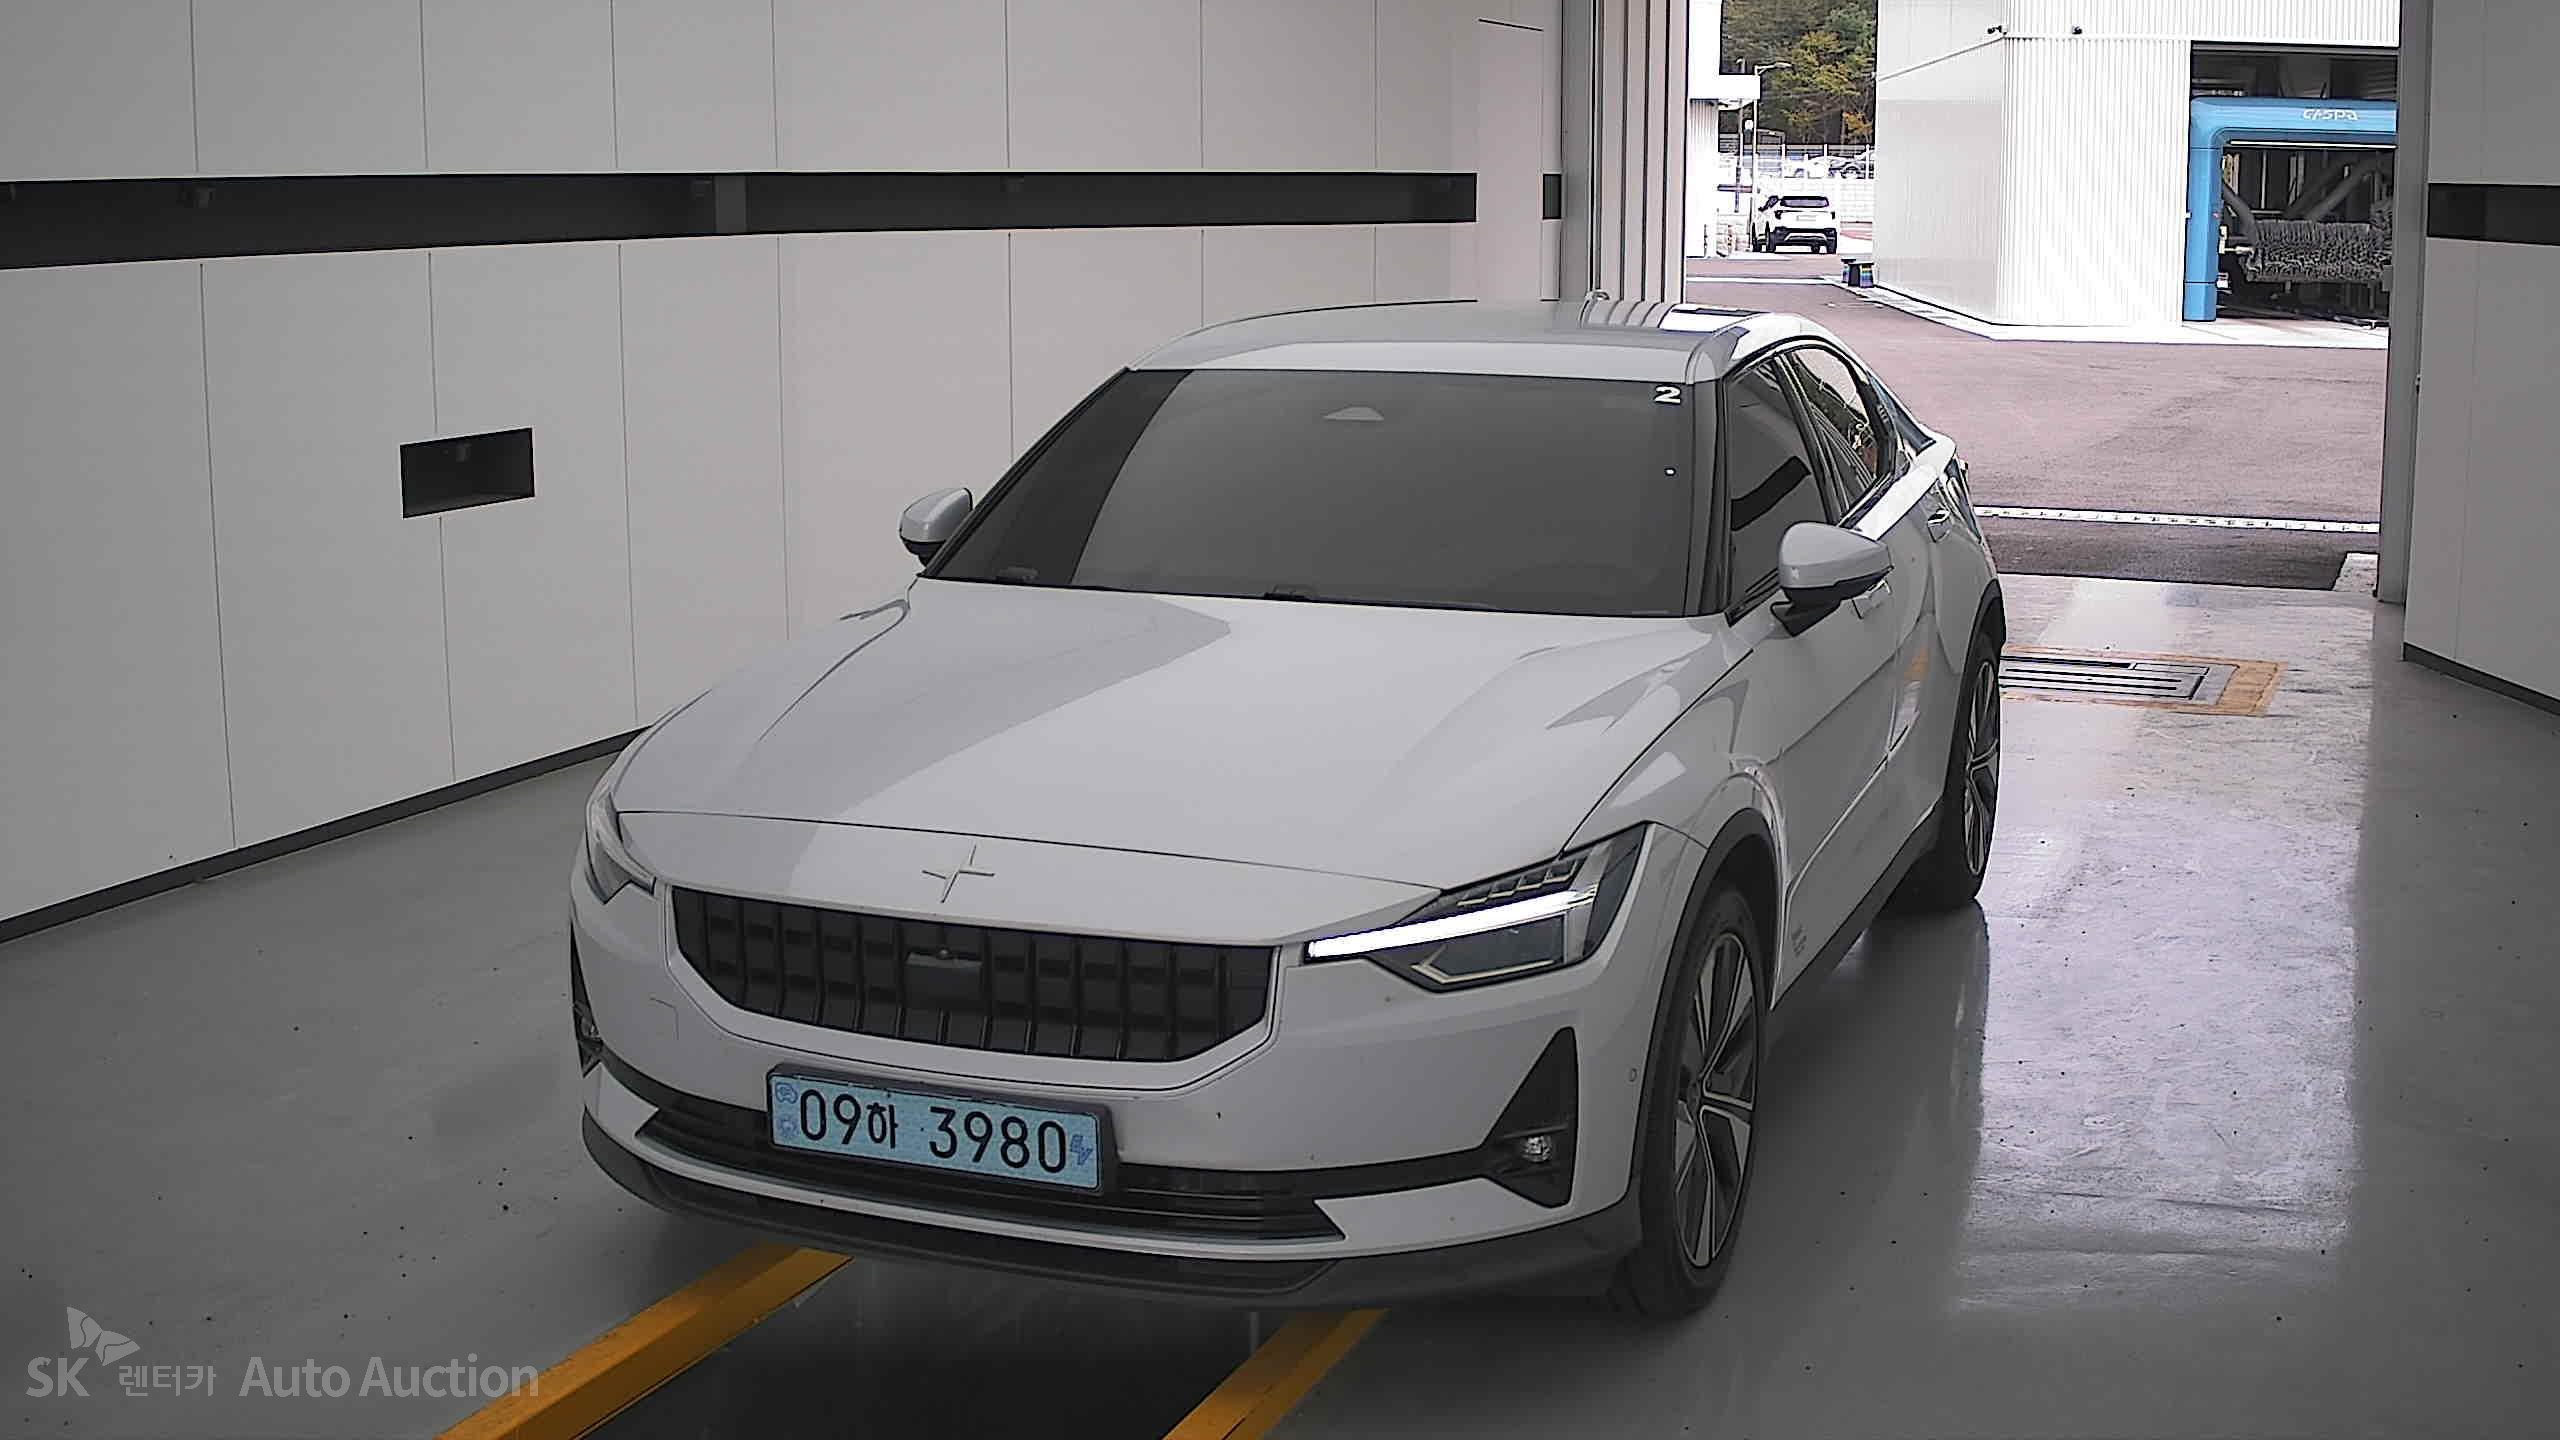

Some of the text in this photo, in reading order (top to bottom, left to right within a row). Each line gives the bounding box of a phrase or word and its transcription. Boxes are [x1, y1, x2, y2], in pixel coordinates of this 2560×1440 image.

[1655, 386, 1681, 403] 2
[800, 1089, 1066, 1173] 09하 3980
